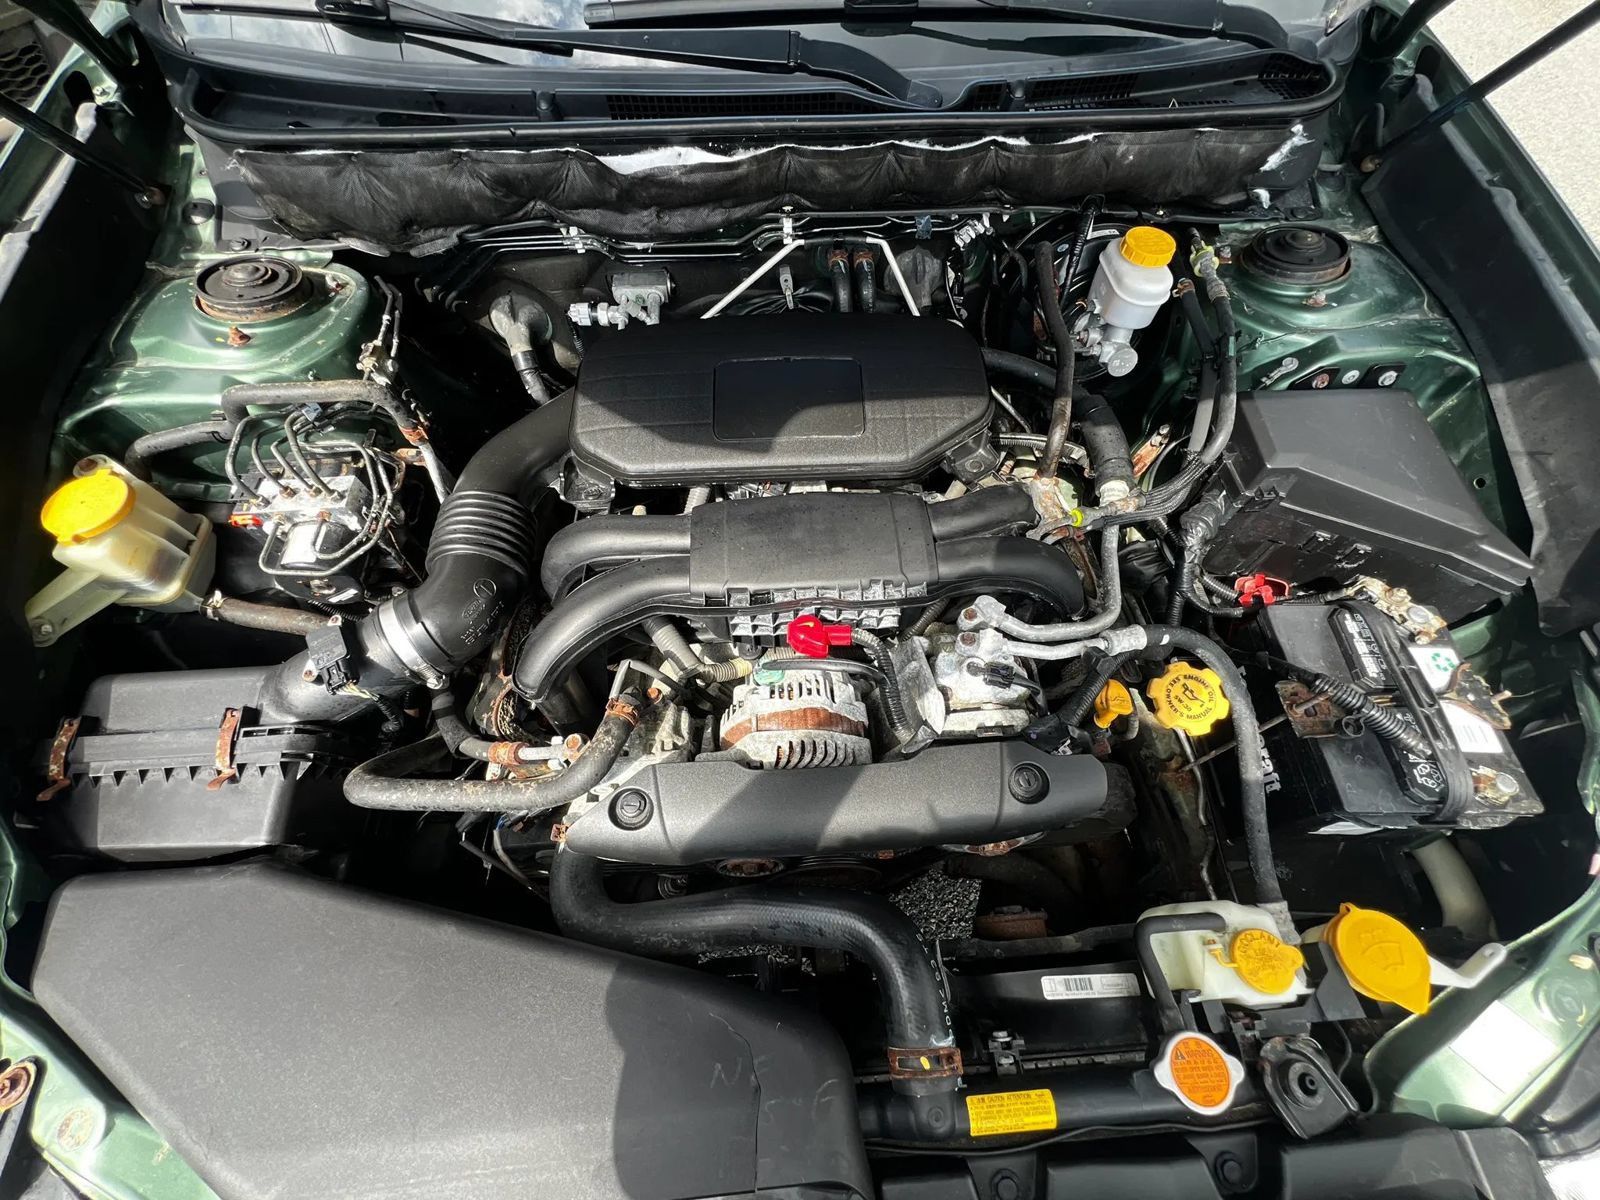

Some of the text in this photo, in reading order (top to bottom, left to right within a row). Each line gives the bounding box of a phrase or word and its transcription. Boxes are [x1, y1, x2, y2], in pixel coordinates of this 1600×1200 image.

[1183, 674, 1209, 690] ENGINE
[1169, 676, 1181, 688] SEE
[1186, 707, 1212, 720] MANUAL
[1238, 932, 1280, 953] COOLANT
